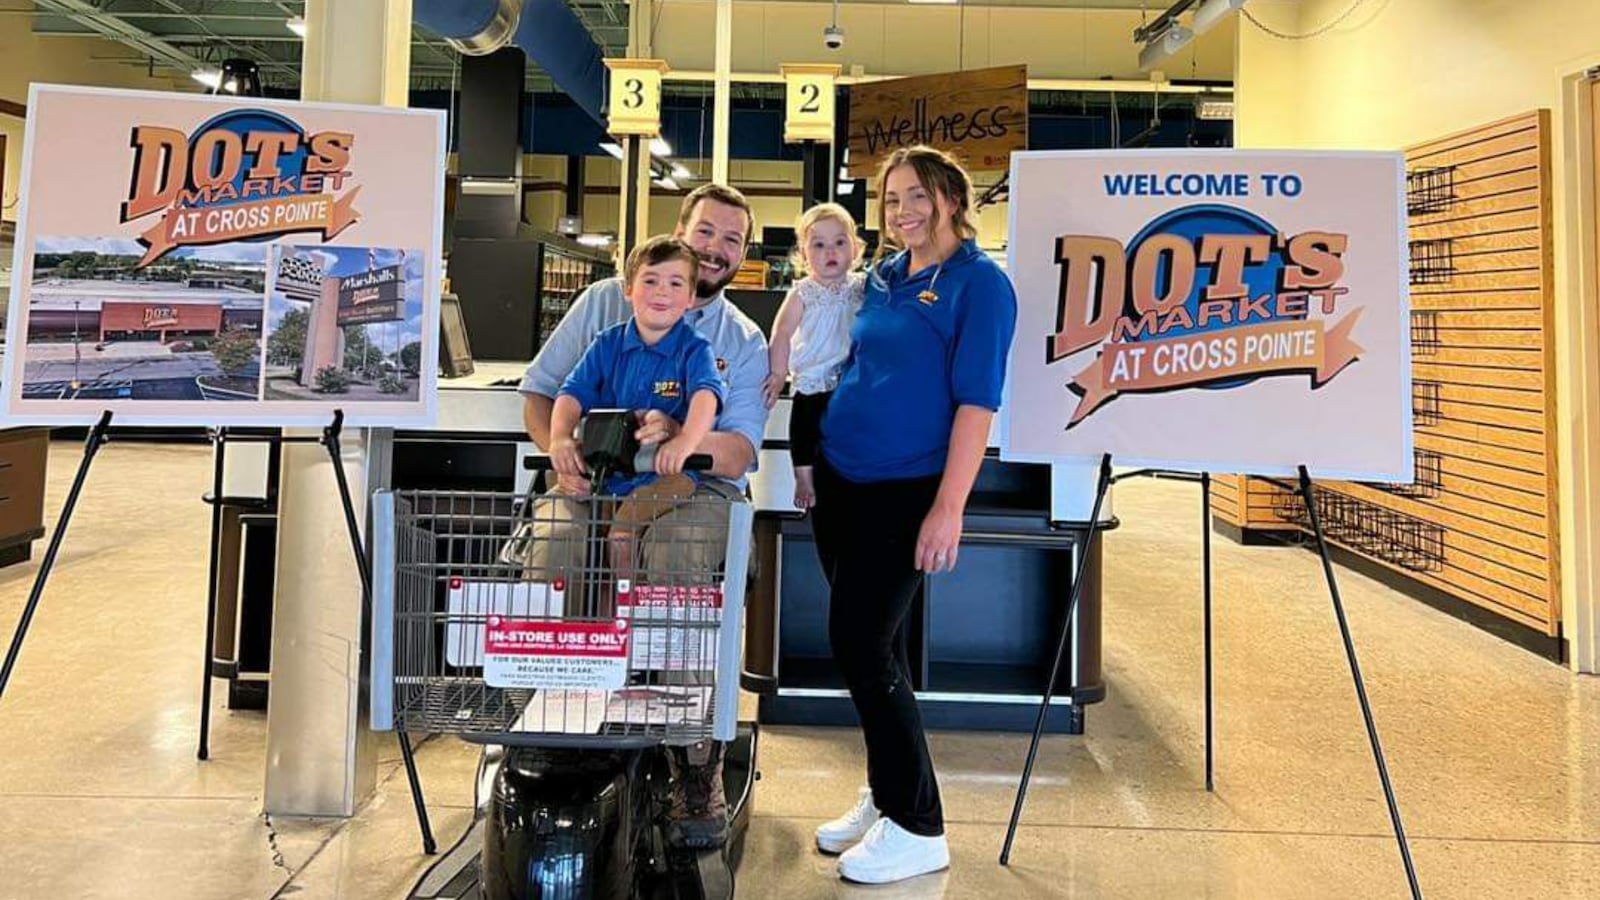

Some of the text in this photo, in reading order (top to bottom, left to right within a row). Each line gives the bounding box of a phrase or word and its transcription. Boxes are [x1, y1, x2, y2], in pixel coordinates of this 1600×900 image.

[623, 79, 644, 109] 3
[799, 84, 820, 112] 2
[121, 125, 354, 224] DOT'S
[174, 171, 353, 208] MARKET
[1104, 173, 1302, 197] WELCOME TO
[171, 200, 327, 239] AT CROSS POINTE
[341, 269, 395, 290] Marshalls
[1046, 231, 1348, 365] DOT'S
[1112, 286, 1349, 343] MARKET
[1110, 329, 1317, 383] AT CROSS POINTE
[489, 630, 627, 646] IN-STORE USE ONLY
[517, 665, 554, 673] BECAUSE
